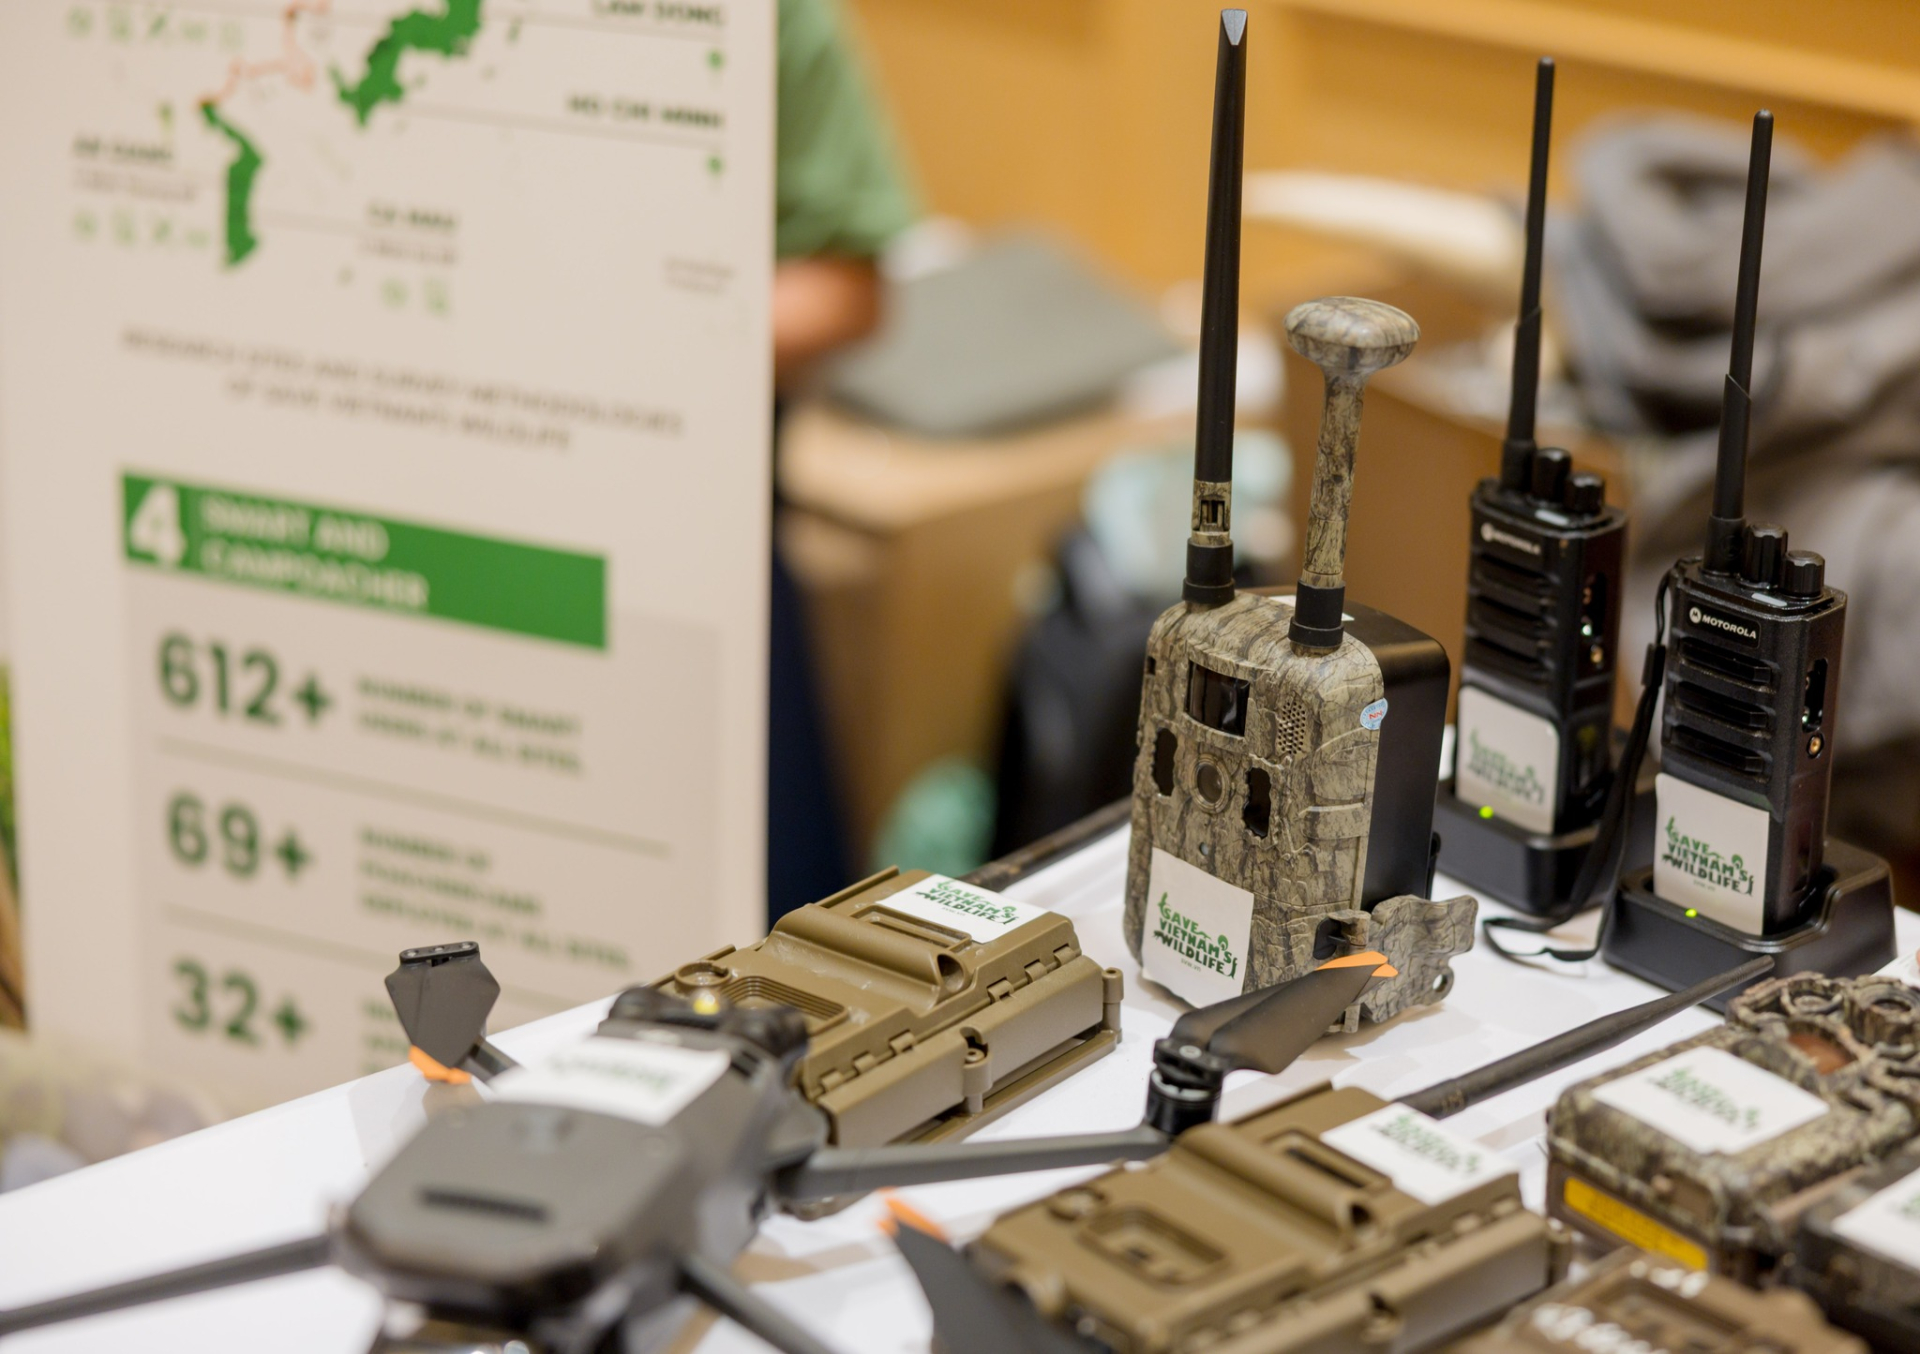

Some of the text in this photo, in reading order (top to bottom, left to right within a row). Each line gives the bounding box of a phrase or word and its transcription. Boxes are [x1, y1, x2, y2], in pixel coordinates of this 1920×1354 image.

[130, 484, 188, 568] 4
[1702, 614, 1757, 639] MOTOROLA
[1160, 918, 1232, 964] VIETNAM'S
